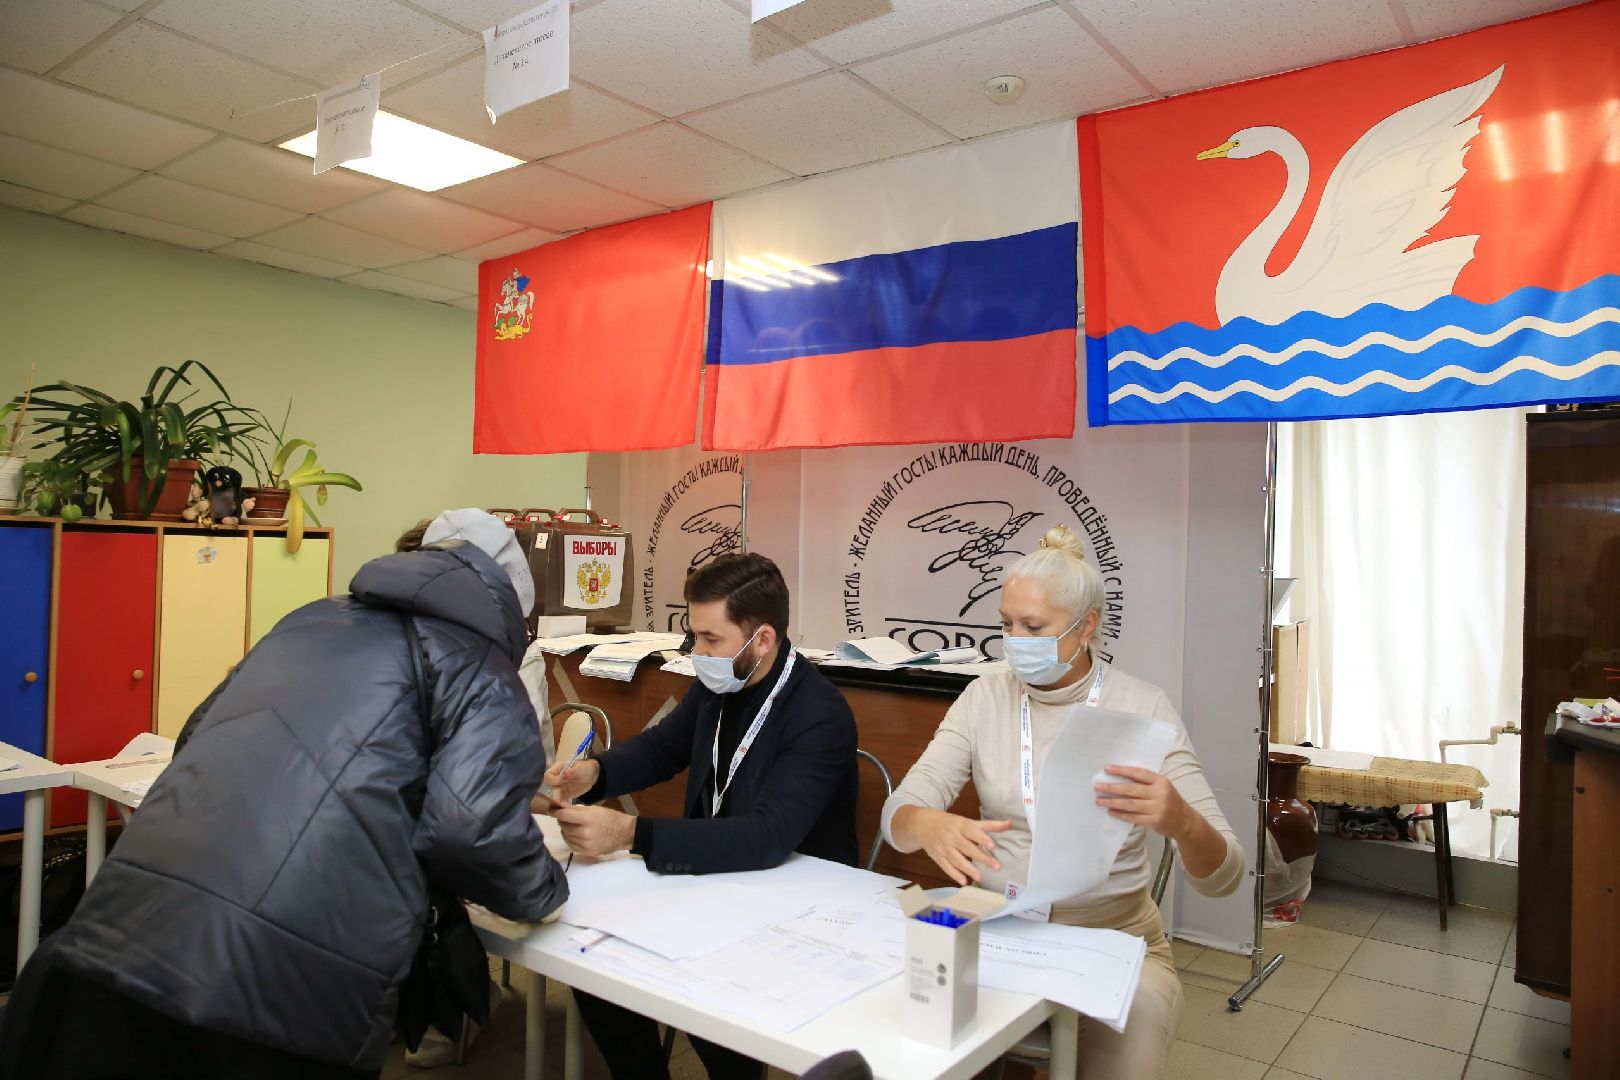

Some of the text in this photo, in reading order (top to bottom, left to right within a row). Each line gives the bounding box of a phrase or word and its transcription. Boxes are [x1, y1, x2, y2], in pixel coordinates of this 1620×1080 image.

[892, 450, 938, 491] ГОСТЬ!
[937, 442, 1004, 467] КАЖДЫЙ
[1004, 446, 1041, 480] ДЕНЬ,
[643, 566, 654, 618] ЗРИТЕЛЬ
[671, 465, 699, 500] ГОСТЬ!
[699, 454, 740, 478] КАЖДЫЙ
[848, 481, 899, 561] ЖЕЛАННЫЙ
[1041, 465, 1123, 573] ПРОВЕДЁННЫЙ
[572, 540, 617, 556] ВЫБОРЫ
[844, 571, 864, 634] ЗРИТЕЛЬ
[1104, 576, 1122, 586] С
[1101, 591, 1123, 640] НАМИ
